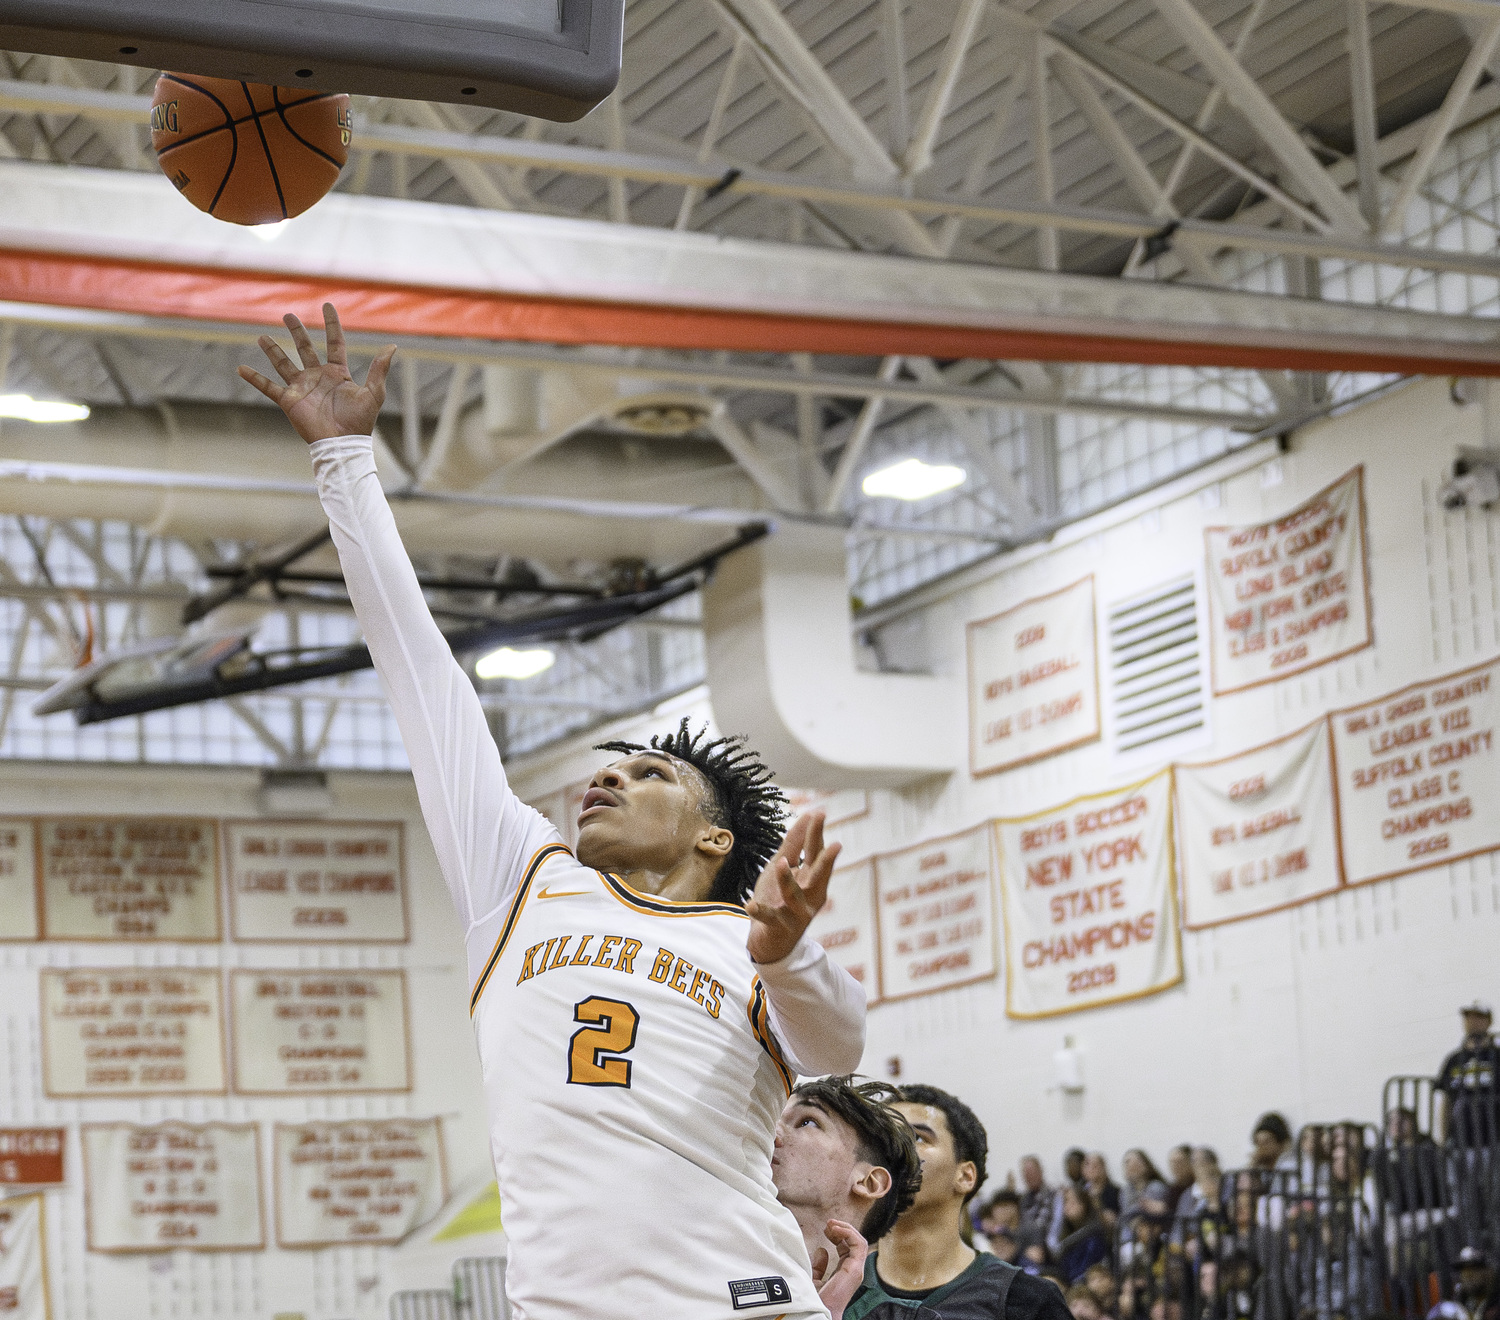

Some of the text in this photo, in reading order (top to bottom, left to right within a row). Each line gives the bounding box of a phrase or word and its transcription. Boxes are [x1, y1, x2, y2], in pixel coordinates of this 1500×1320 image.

[1303, 571, 1346, 608] STATE
[1431, 674, 1490, 707] COUNTRY
[1352, 729, 1492, 789] SUFFOLK COUNTY
[1369, 716, 1432, 756] LEAGUE
[1388, 769, 1461, 809] CLASS C
[1020, 795, 1147, 853] BOYS SOCCER
[1381, 796, 1473, 841] CHAMPIONS
[1025, 832, 1147, 890] NEW YORK
[1050, 877, 1125, 924] STATE
[1022, 910, 1156, 969] CHAMPIONS
[516, 935, 725, 1020] KILLER BEES
[566, 994, 640, 1089] 2
[773, 1284, 783, 1296] S
